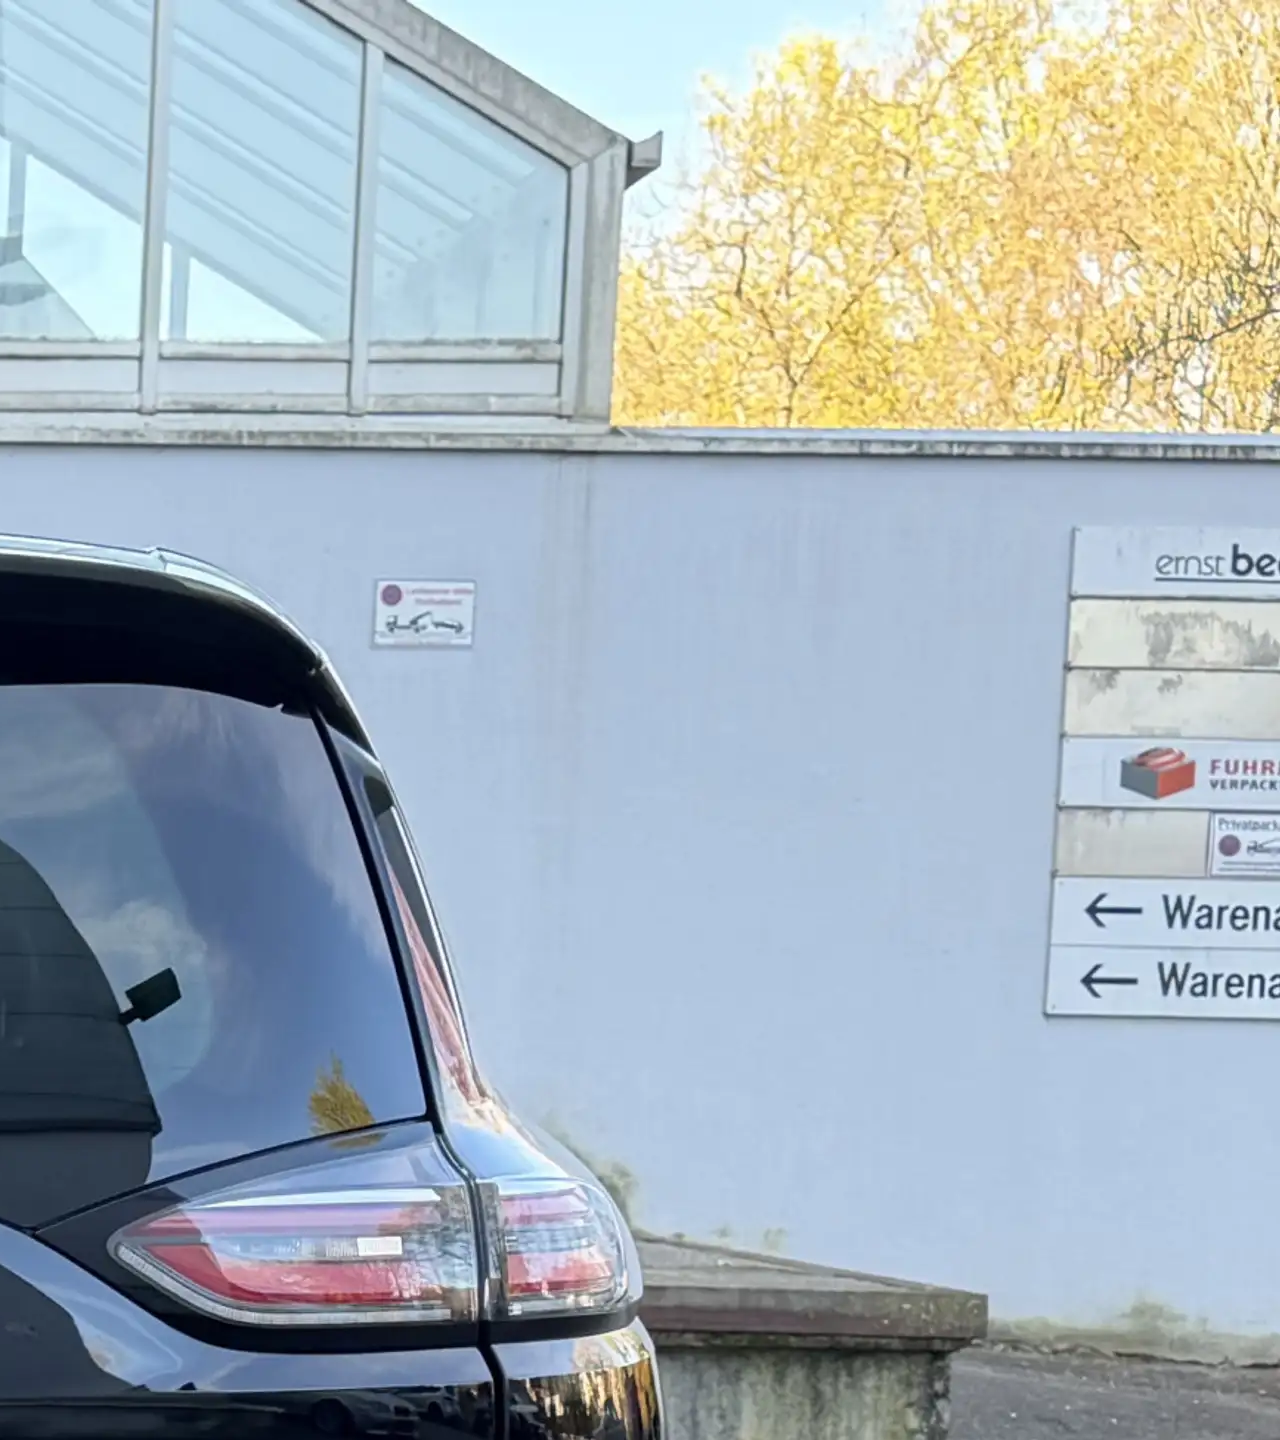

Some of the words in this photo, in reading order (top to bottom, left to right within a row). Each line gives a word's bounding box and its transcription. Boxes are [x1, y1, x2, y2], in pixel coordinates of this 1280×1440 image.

[1156, 554, 1224, 576] ernst
[1231, 543, 1280, 577] be
[1209, 779, 1280, 790] VERPACK
